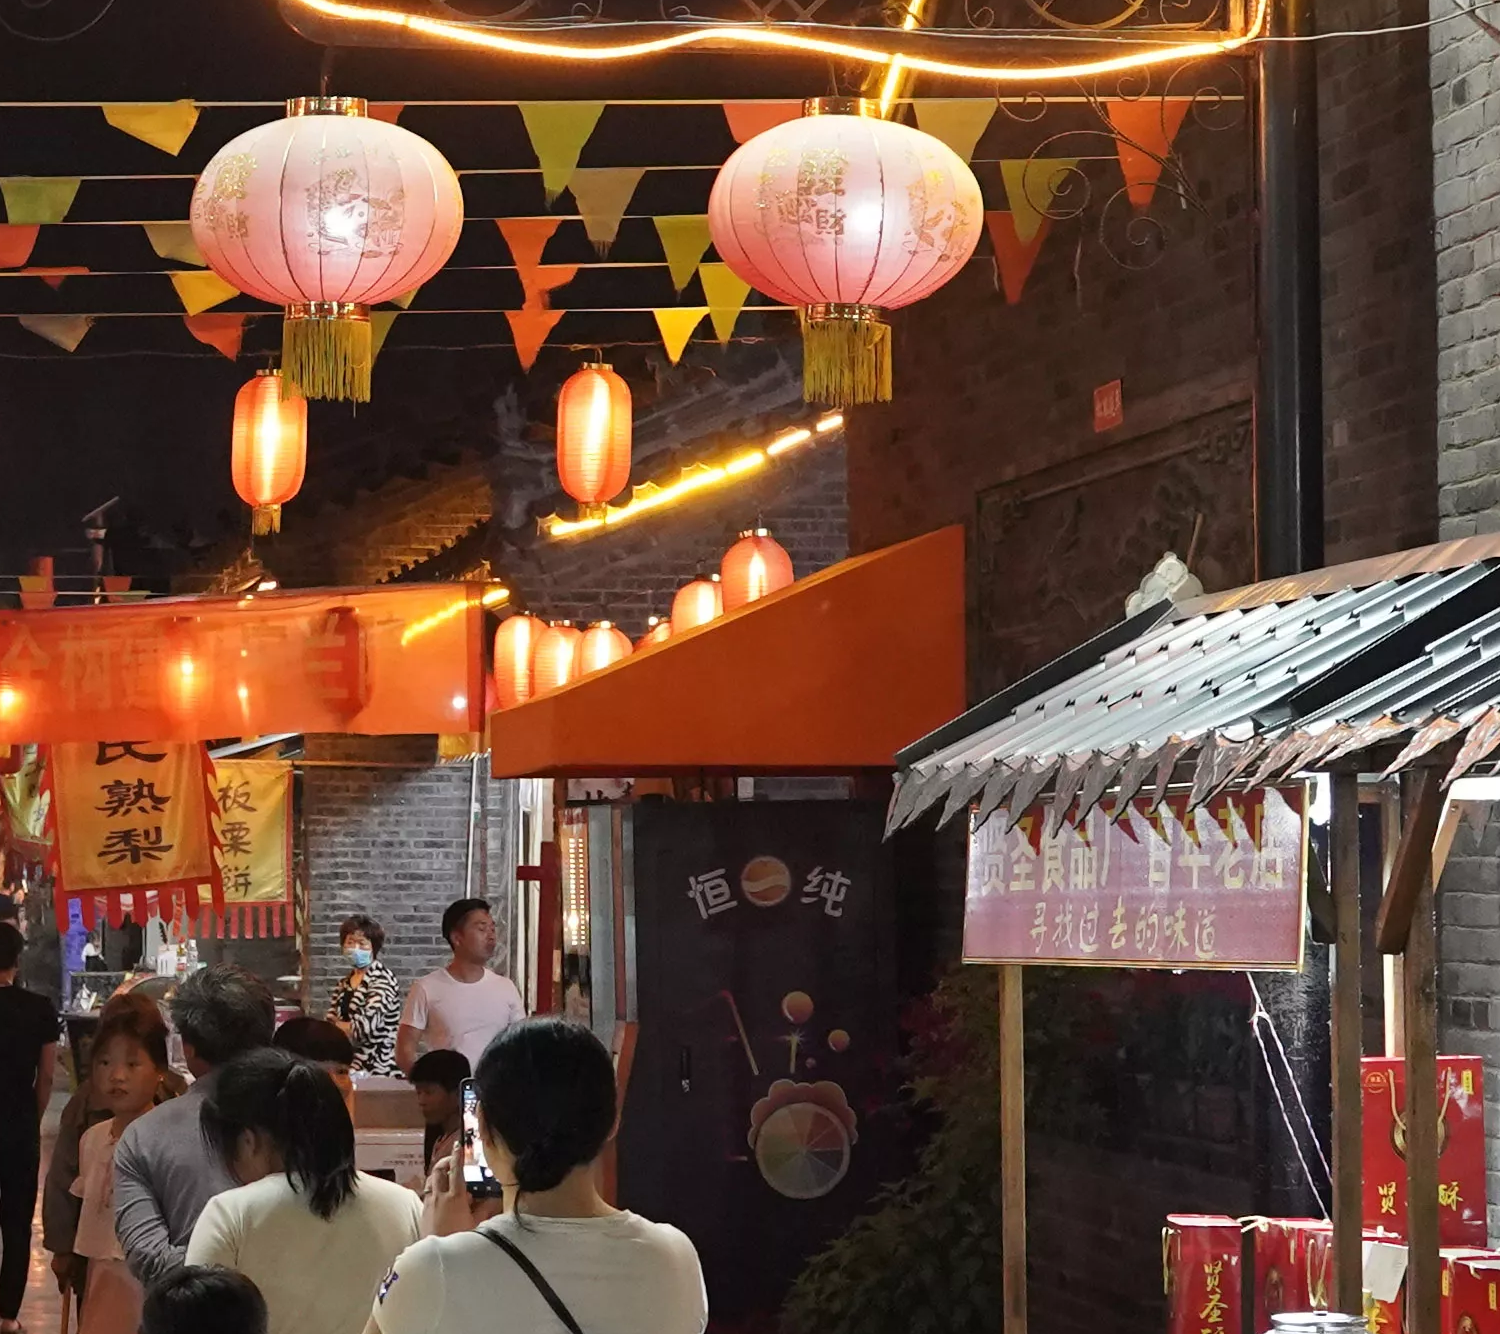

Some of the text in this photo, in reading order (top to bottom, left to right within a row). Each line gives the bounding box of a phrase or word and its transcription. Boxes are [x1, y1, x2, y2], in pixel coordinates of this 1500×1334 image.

[1029, 896, 1218, 960] 寻找过去的味道
[1377, 1180, 1465, 1216] 贤酥
